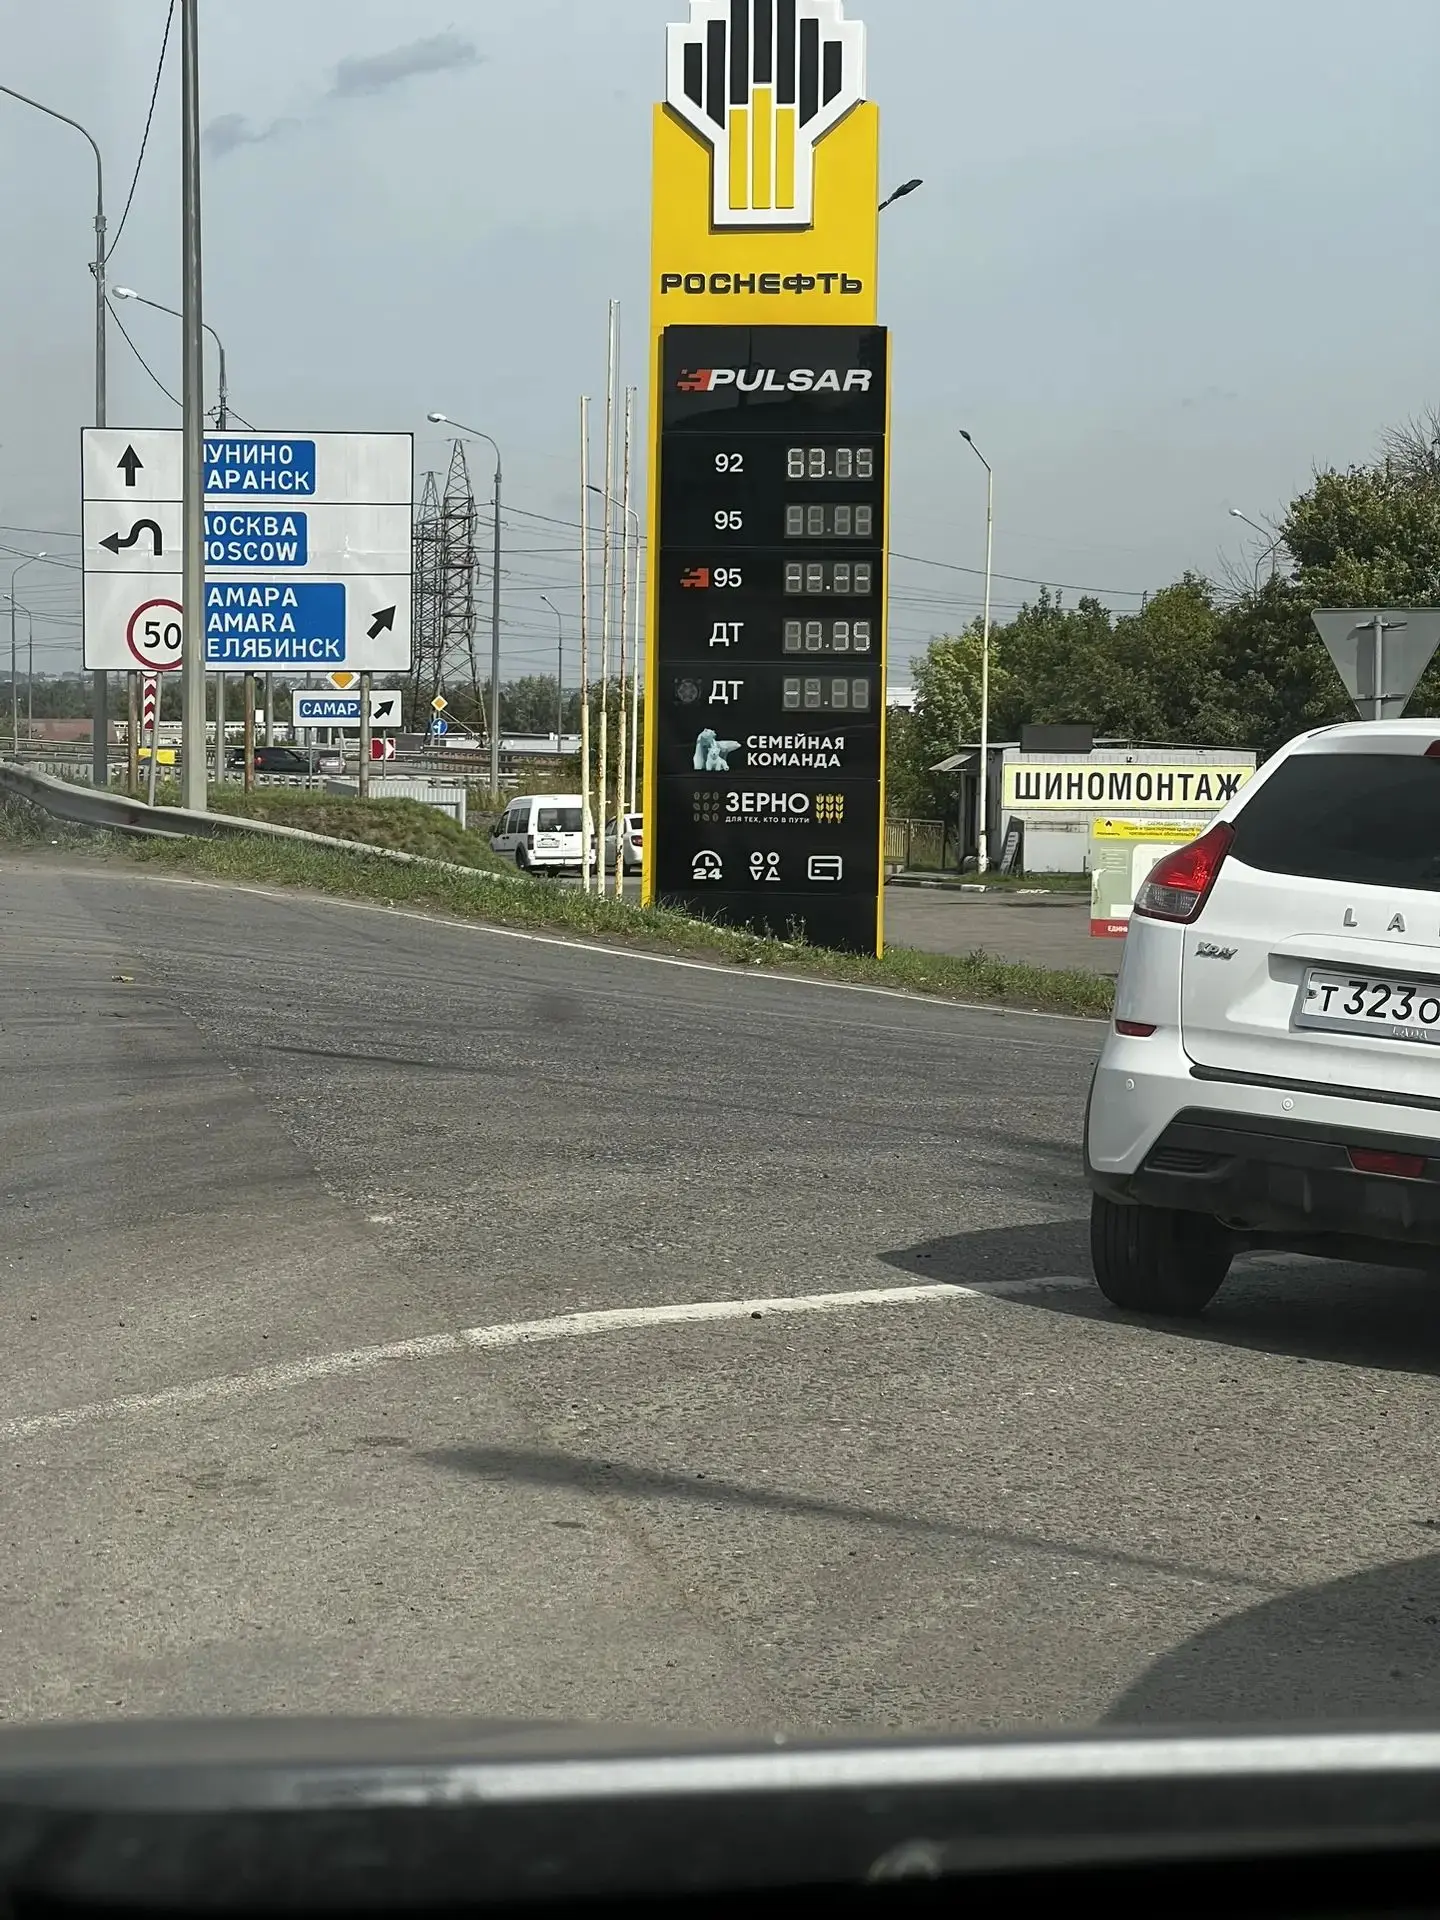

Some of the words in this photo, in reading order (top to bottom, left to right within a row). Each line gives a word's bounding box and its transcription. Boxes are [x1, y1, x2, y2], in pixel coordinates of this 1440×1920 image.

[660, 272, 863, 295] РОСНЕФТЬ
[706, 368, 873, 392] PULSAR
[203, 444, 293, 464] УНИНО
[715, 453, 744, 473] 92
[207, 470, 310, 490] АРАНСК
[204, 516, 298, 536] ОСКВА
[714, 510, 743, 530] 95
[204, 541, 298, 561] OSCOW
[713, 567, 742, 588] 95
[207, 587, 298, 607] АМАРА
[207, 612, 296, 633] AMARA
[143, 621, 182, 650] 50
[709, 622, 744, 647] ДТ
[207, 637, 341, 658] ЕЛЯБИНСК
[708, 680, 744, 705] ДТ
[302, 702, 361, 716] САМАР
[746, 733, 845, 750] СЕМЕЙНАЯ
[747, 752, 841, 769] КОМАНДА
[1015, 772, 1242, 801] ШИНОМОНТАЖ
[725, 791, 810, 814] ЗЕРНО
[725, 815, 742, 823] ДЛЯ
[763, 816, 779, 824] КТО
[788, 817, 810, 825] ПУТИ
[692, 867, 723, 880] 24
[1343, 907, 1440, 937] LA
